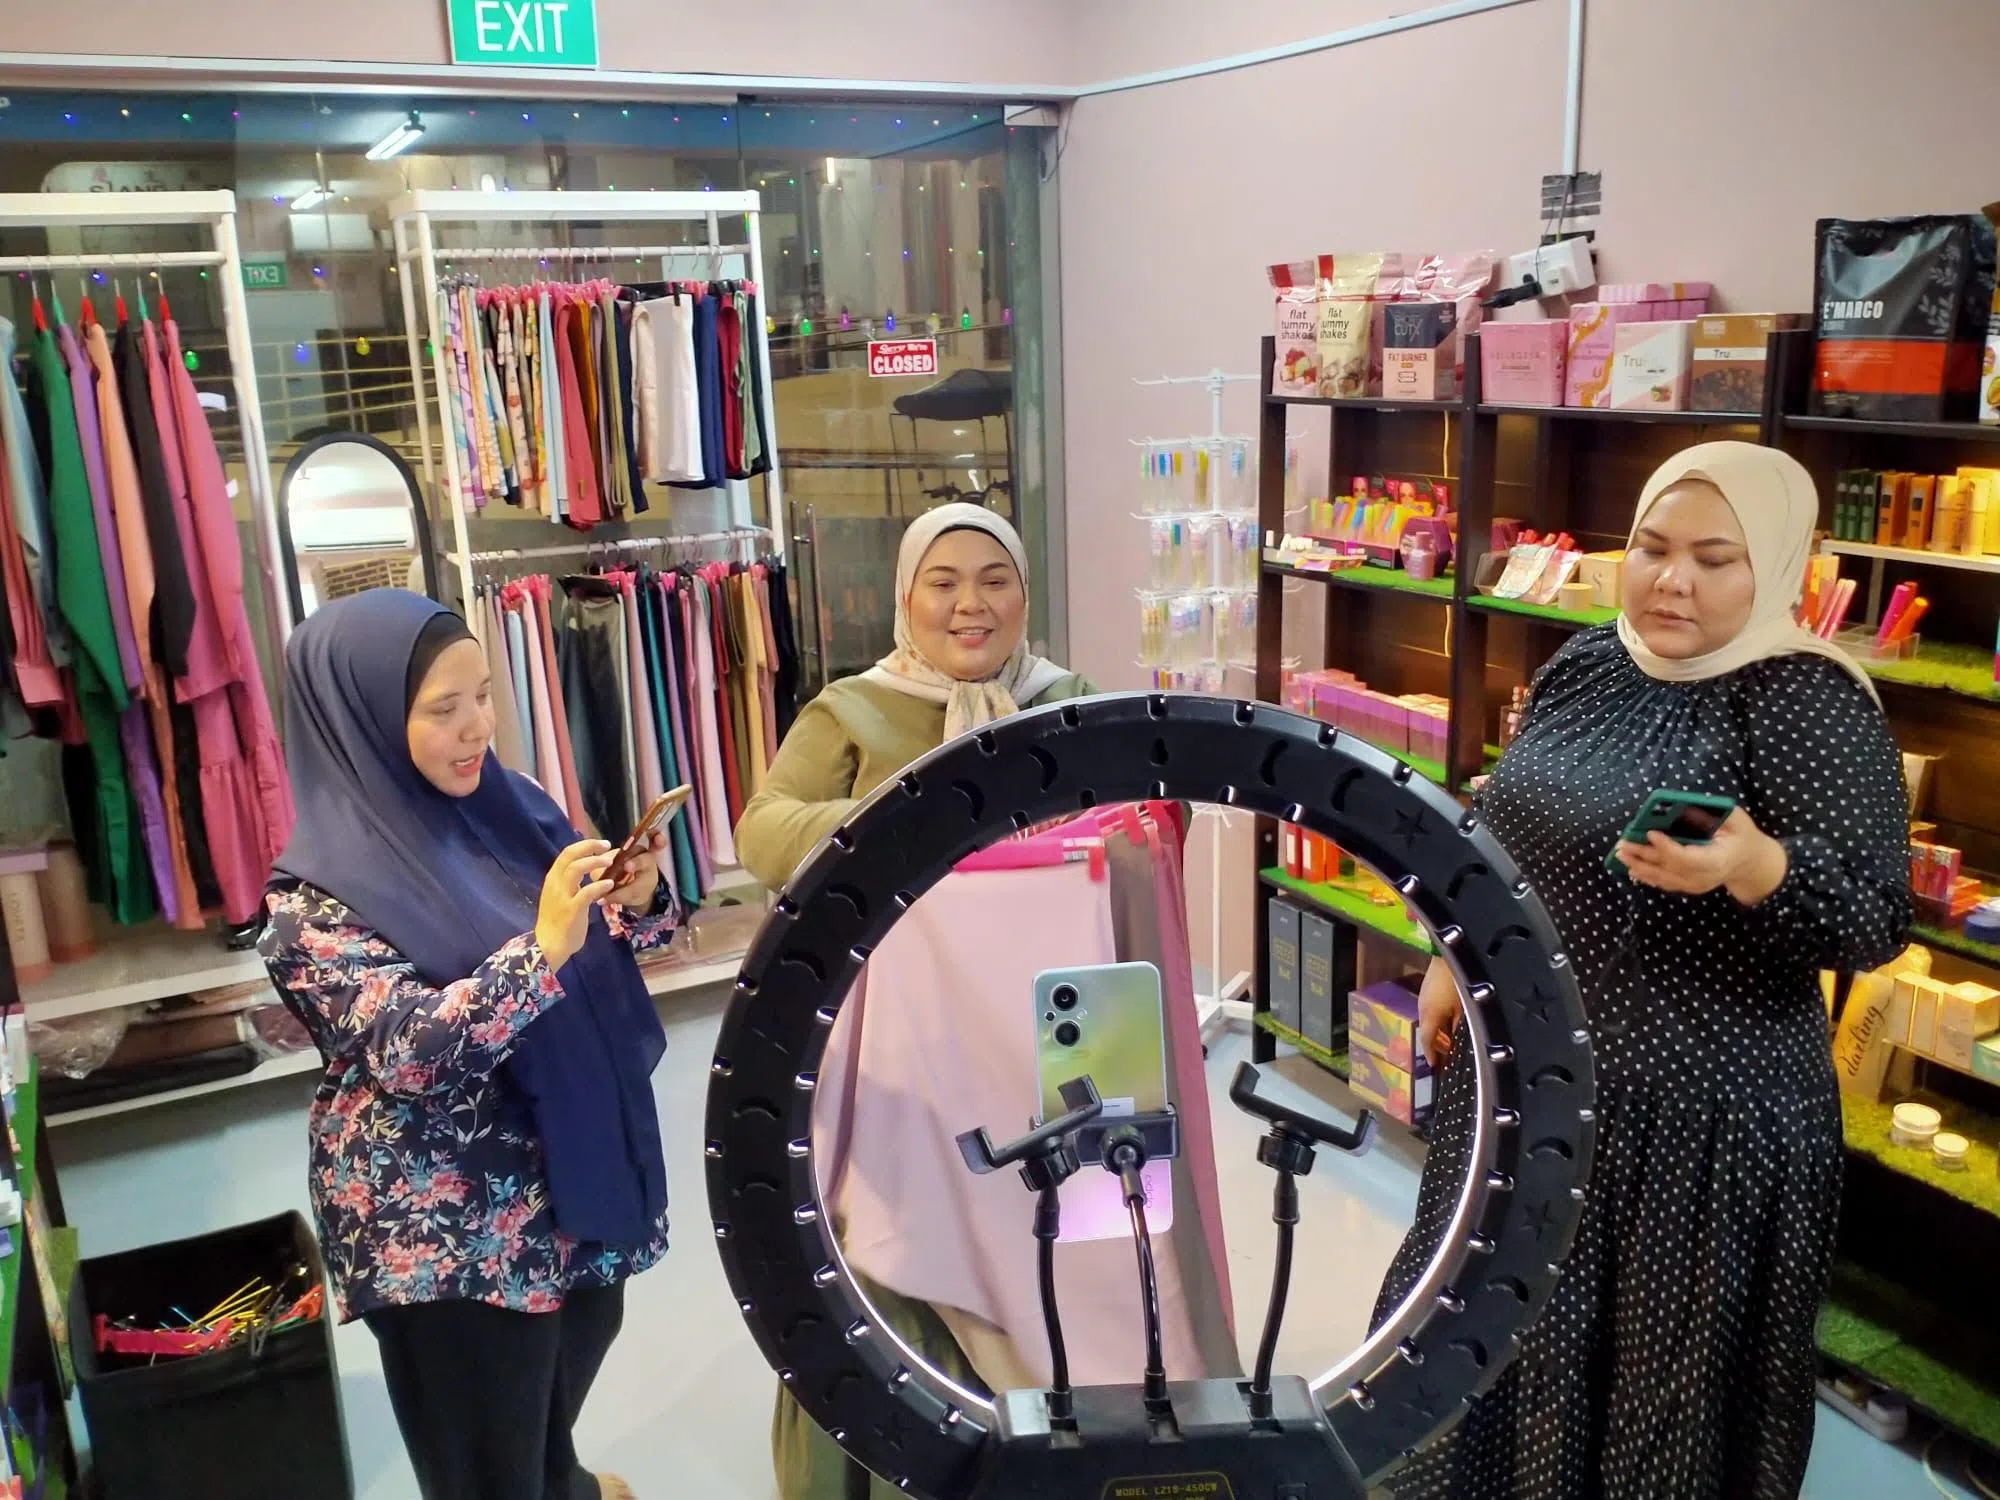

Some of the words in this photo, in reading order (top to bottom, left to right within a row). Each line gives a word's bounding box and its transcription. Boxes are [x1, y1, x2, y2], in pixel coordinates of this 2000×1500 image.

[475, 1, 568, 53] EXIT
[1289, 309, 1307, 319] flat
[1327, 307, 1342, 318] flat
[1823, 301, 1884, 319] E'MARCO
[1281, 321, 1315, 331] tummy
[1320, 329, 1347, 339] shakes
[1401, 353, 1428, 361] BURNER
[873, 354, 932, 373] CLOSED
[1115, 1487, 1148, 1497] MODEL
